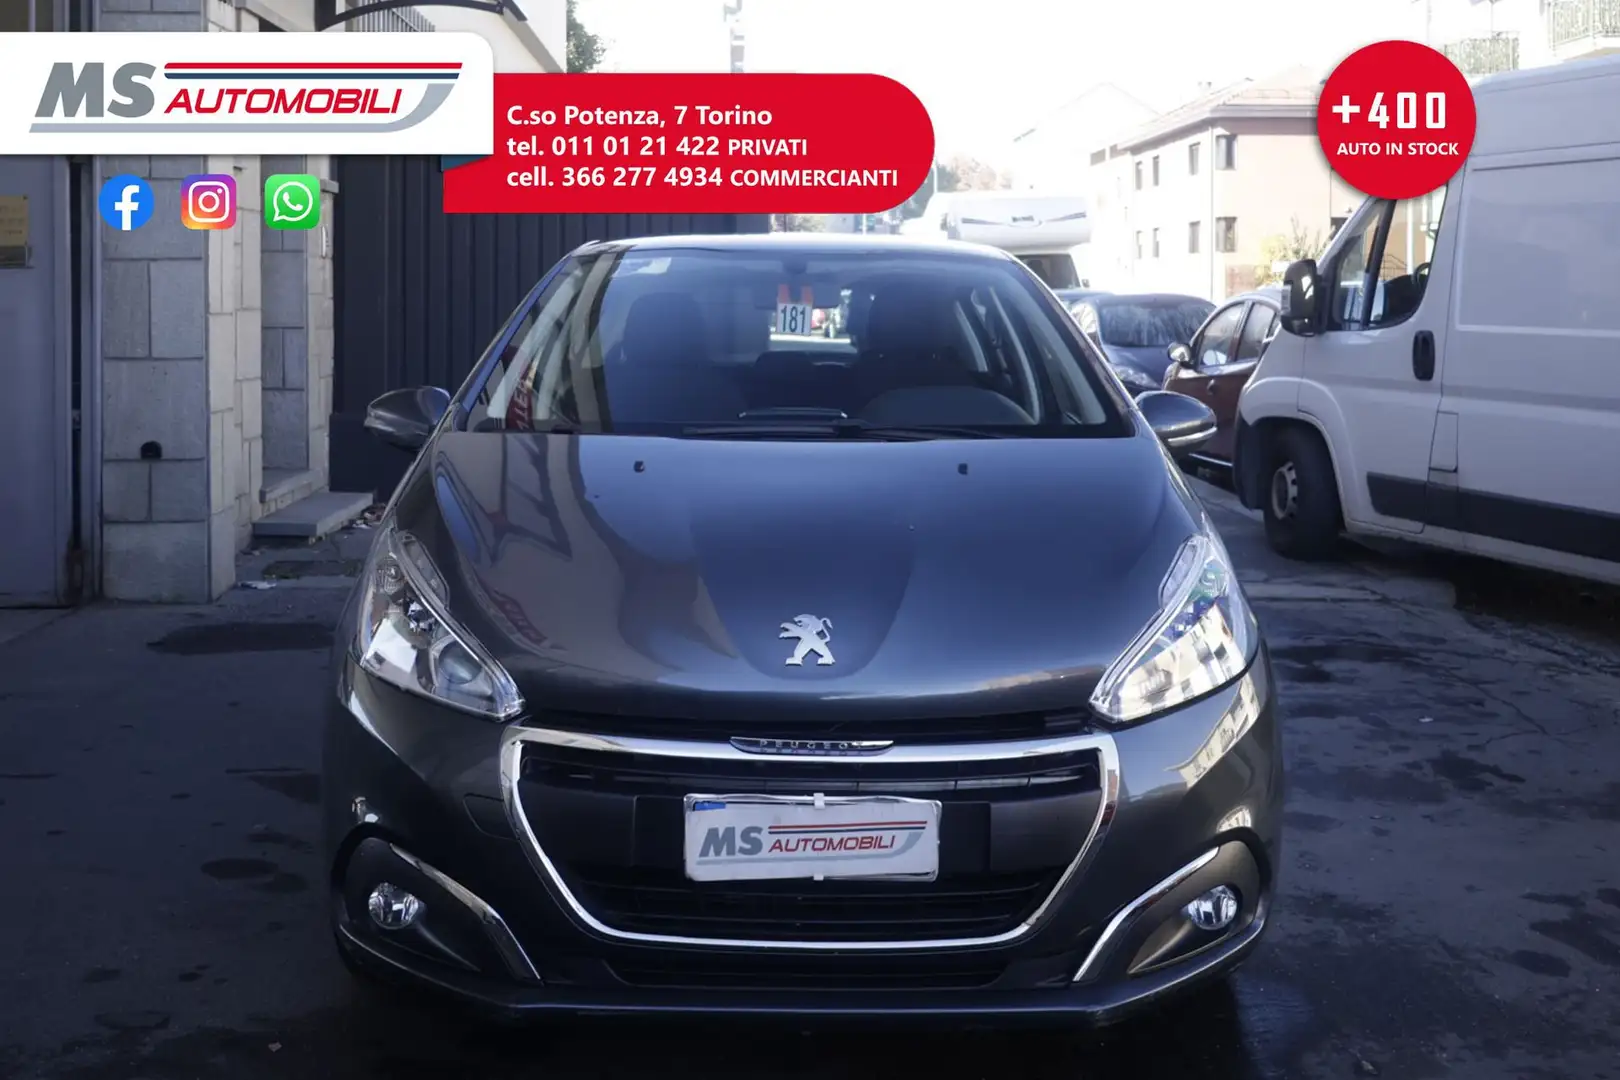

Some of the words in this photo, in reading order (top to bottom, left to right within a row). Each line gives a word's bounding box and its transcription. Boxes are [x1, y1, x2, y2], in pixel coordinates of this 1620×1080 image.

[781, 305, 807, 333] 181
[699, 826, 764, 858] MS
[768, 835, 896, 853] AUTOMOBILI
